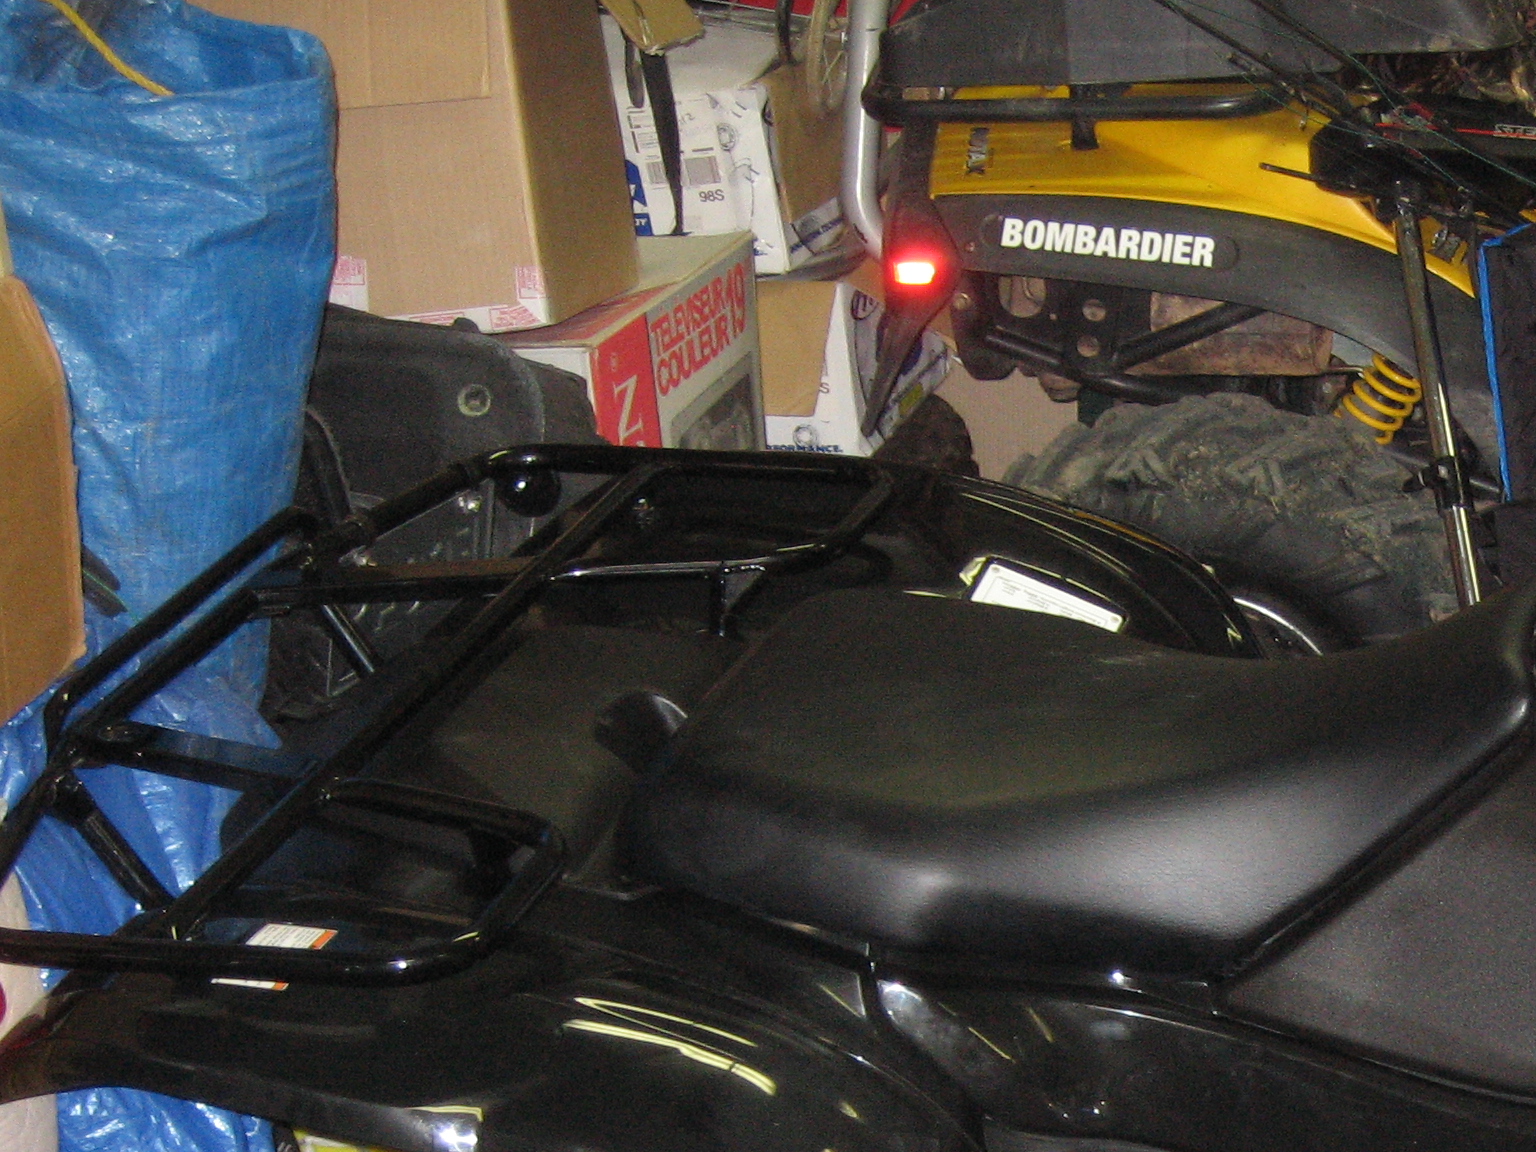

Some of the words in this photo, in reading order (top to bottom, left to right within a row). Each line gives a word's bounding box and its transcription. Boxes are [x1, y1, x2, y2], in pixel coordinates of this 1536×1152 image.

[699, 189, 725, 202] 98S
[1001, 218, 1215, 267] BOMBARDIER
[658, 314, 730, 396] COULEUR
